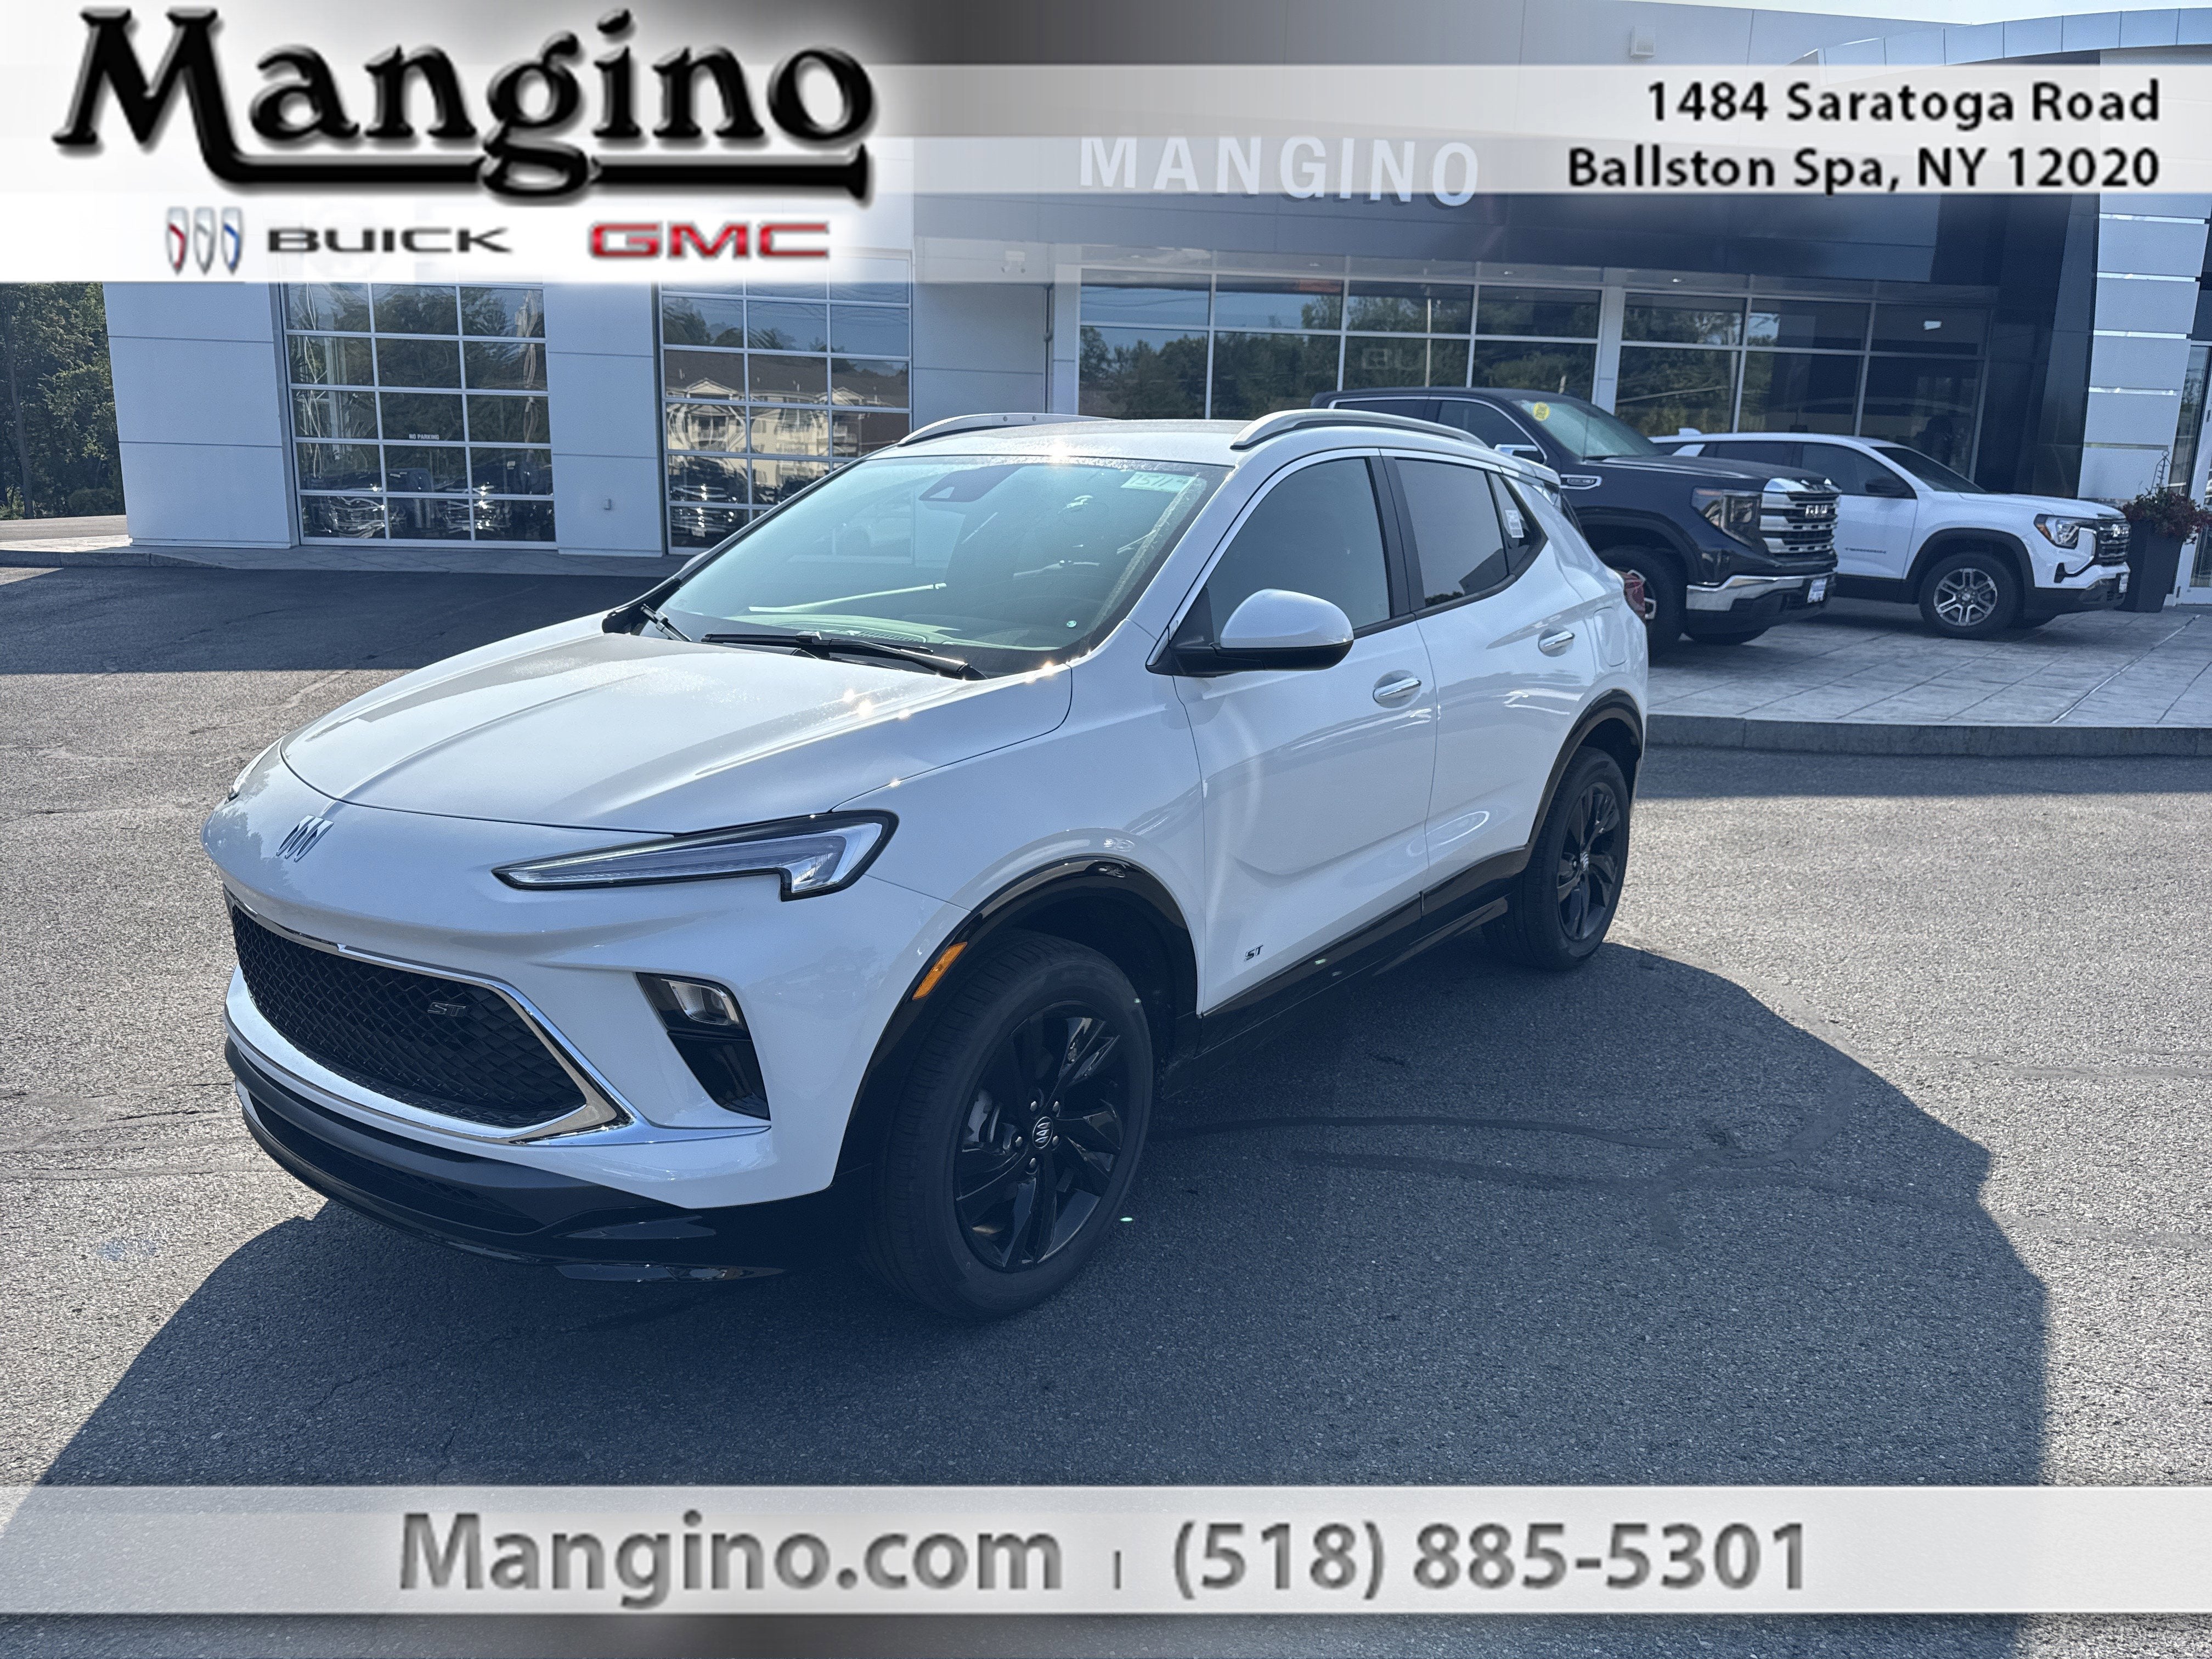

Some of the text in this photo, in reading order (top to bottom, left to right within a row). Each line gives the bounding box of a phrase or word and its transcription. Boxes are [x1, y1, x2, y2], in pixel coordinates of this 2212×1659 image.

[1080, 129, 1479, 207] MANGINO
[1244, 944, 1263, 962] ST
[428, 1001, 467, 1017] ST
